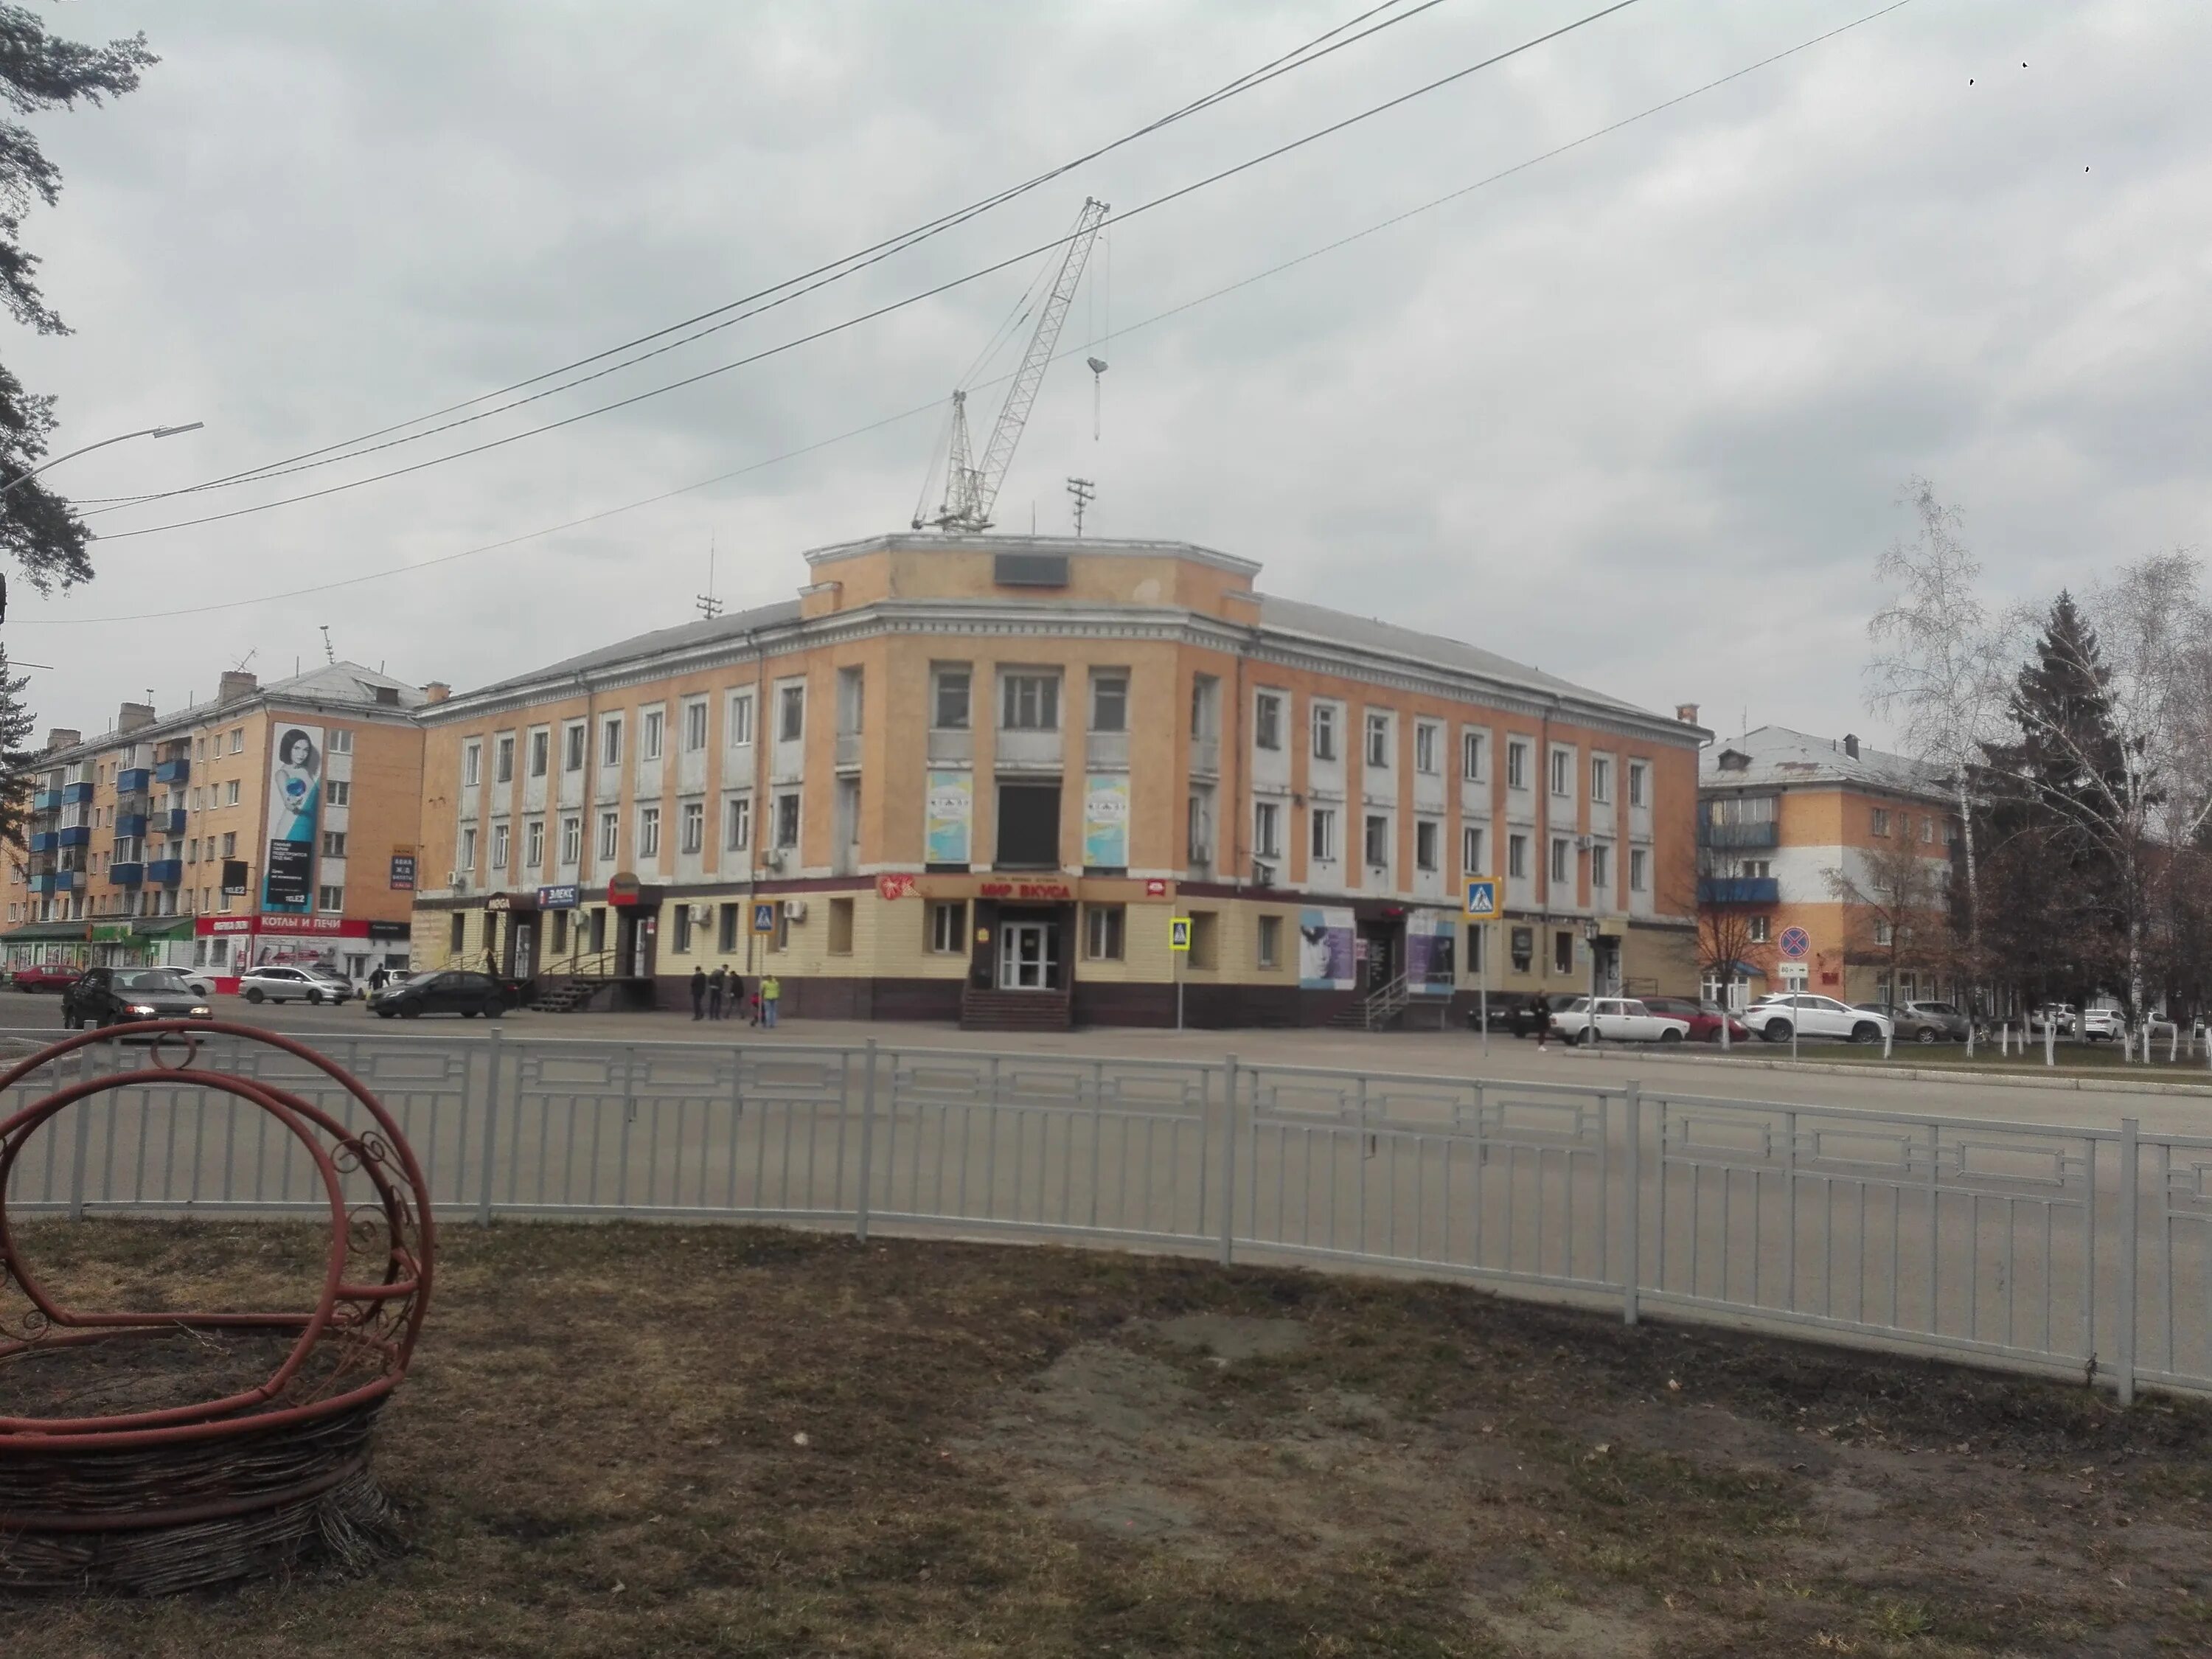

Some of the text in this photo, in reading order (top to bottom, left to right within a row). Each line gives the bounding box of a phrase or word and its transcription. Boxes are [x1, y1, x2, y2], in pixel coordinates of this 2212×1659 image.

[979, 883, 1071, 898] МИР ВКУСА
[261, 916, 341, 929] КОТЛЫ И ПЕЧИ
